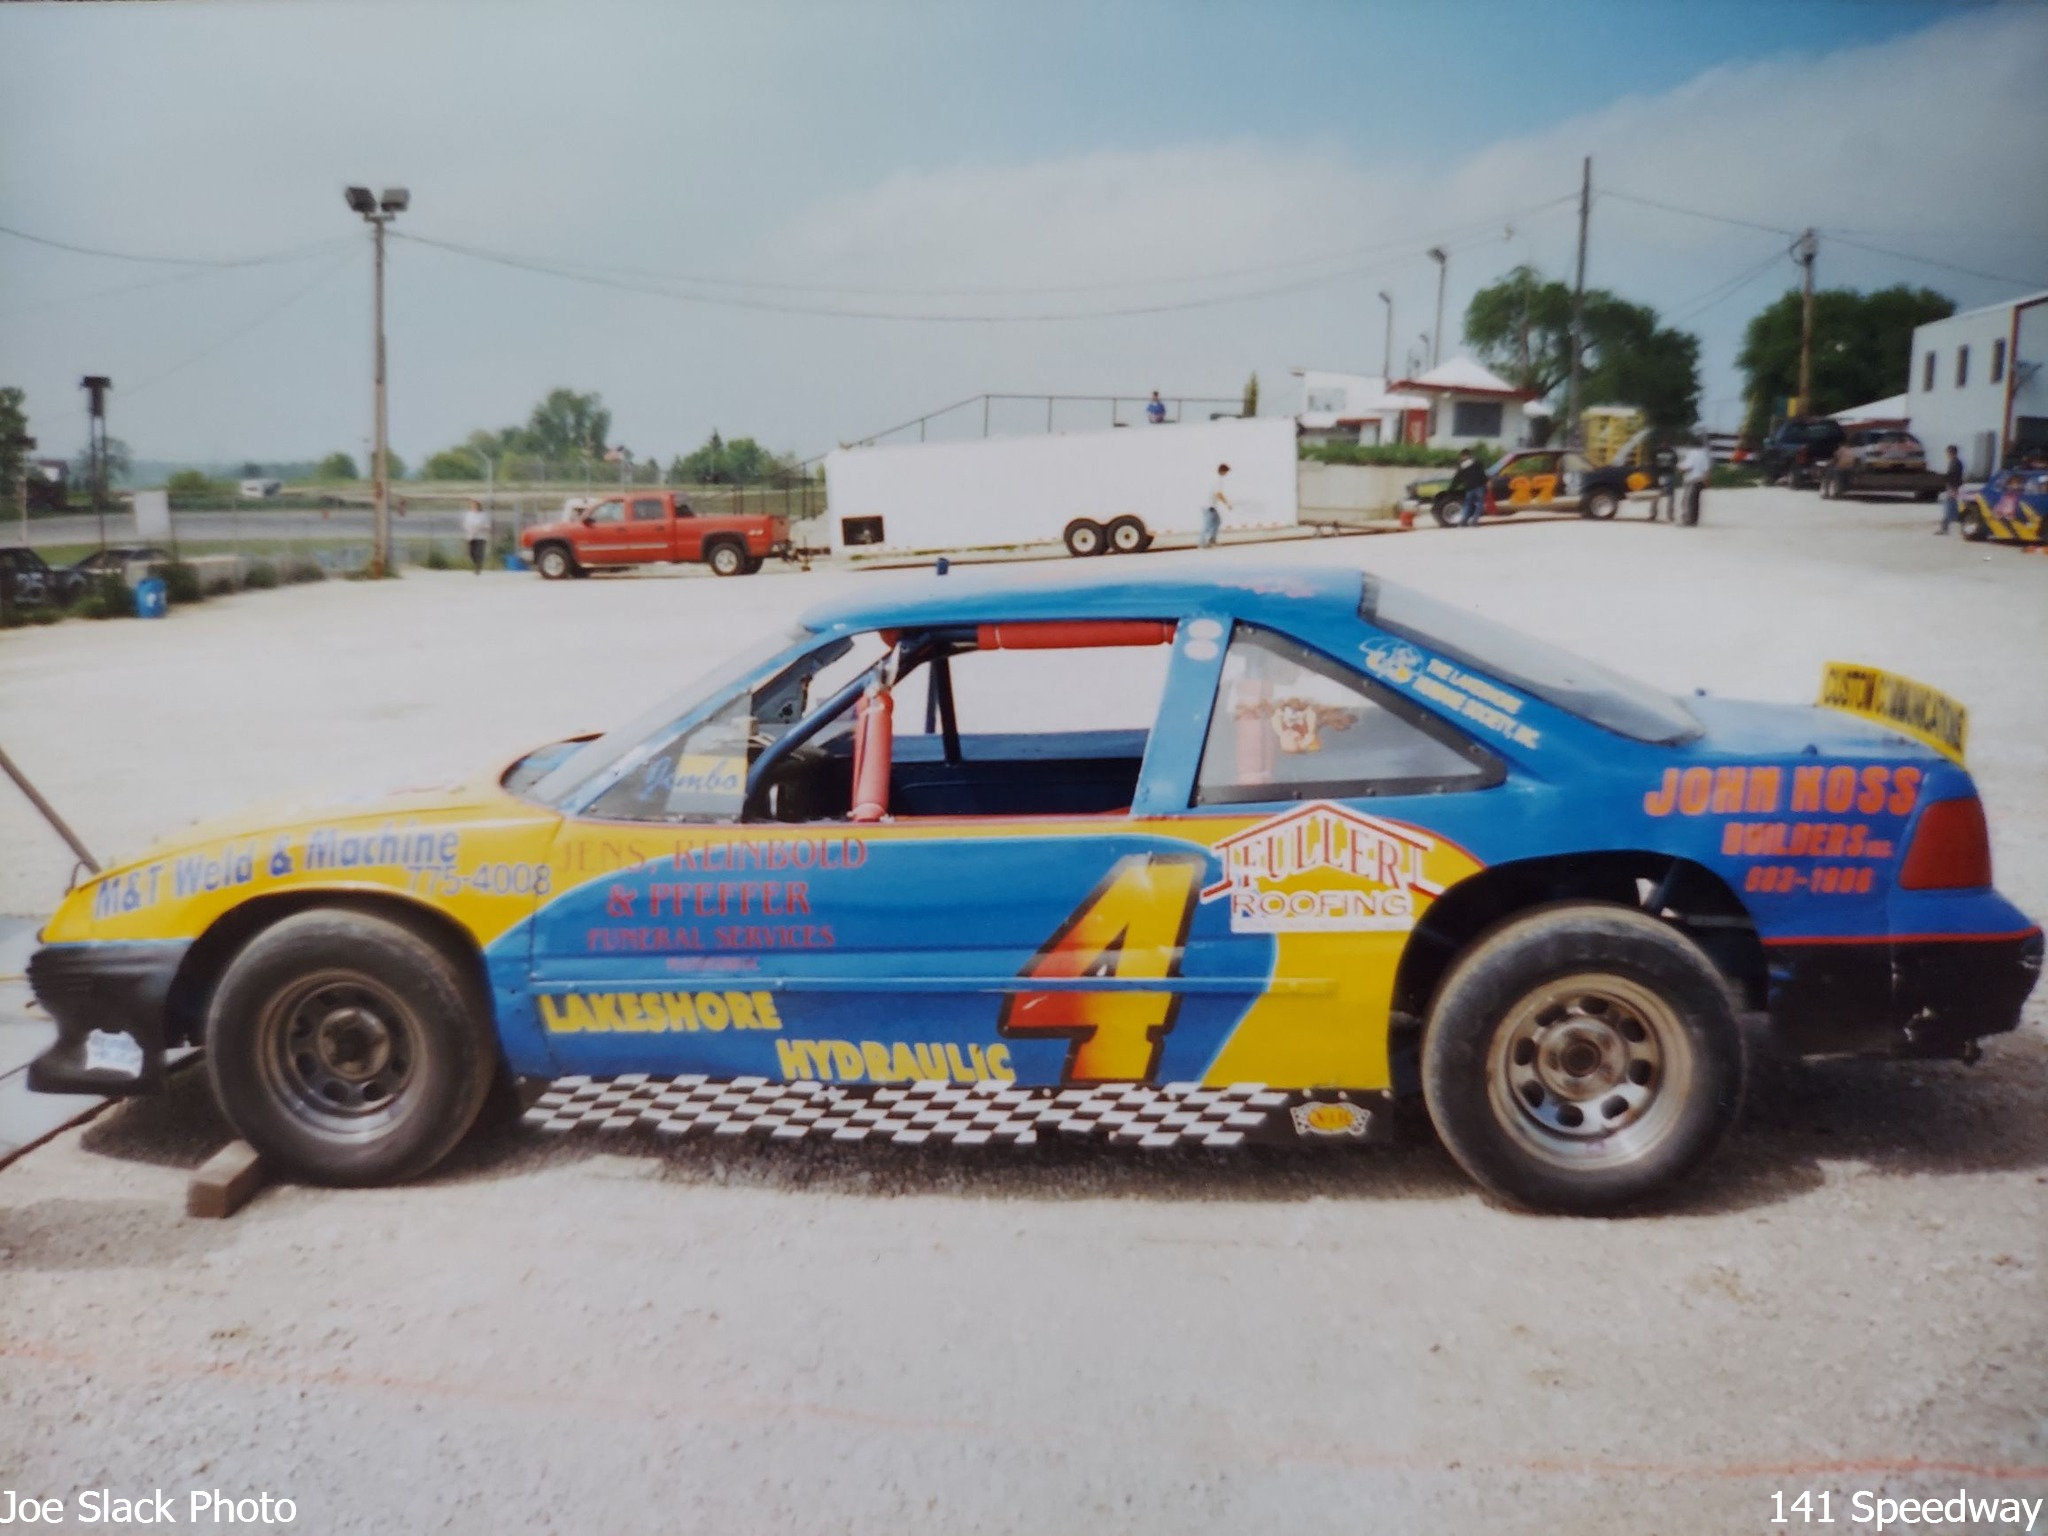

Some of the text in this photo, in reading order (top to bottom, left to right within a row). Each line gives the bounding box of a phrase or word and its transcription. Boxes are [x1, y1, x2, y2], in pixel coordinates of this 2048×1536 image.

[1643, 766, 1921, 816] JOHN KOSS
[174, 840, 255, 897] Weld
[269, 833, 294, 877] &
[305, 818, 461, 871] Machine
[673, 836, 867, 872] REINBOLD
[1242, 816, 1400, 890] FULLER
[1721, 822, 1868, 857] BUILDERS
[405, 863, 552, 896] 775-4008
[607, 880, 812, 918] & PFEFFER
[1233, 891, 1413, 919] ROOFING
[587, 924, 836, 951] FUNERAL SERVICES
[998, 852, 1207, 1086] 4
[540, 991, 782, 1033] LAKESHORE
[775, 1038, 1016, 1085] HYDRAULIC
